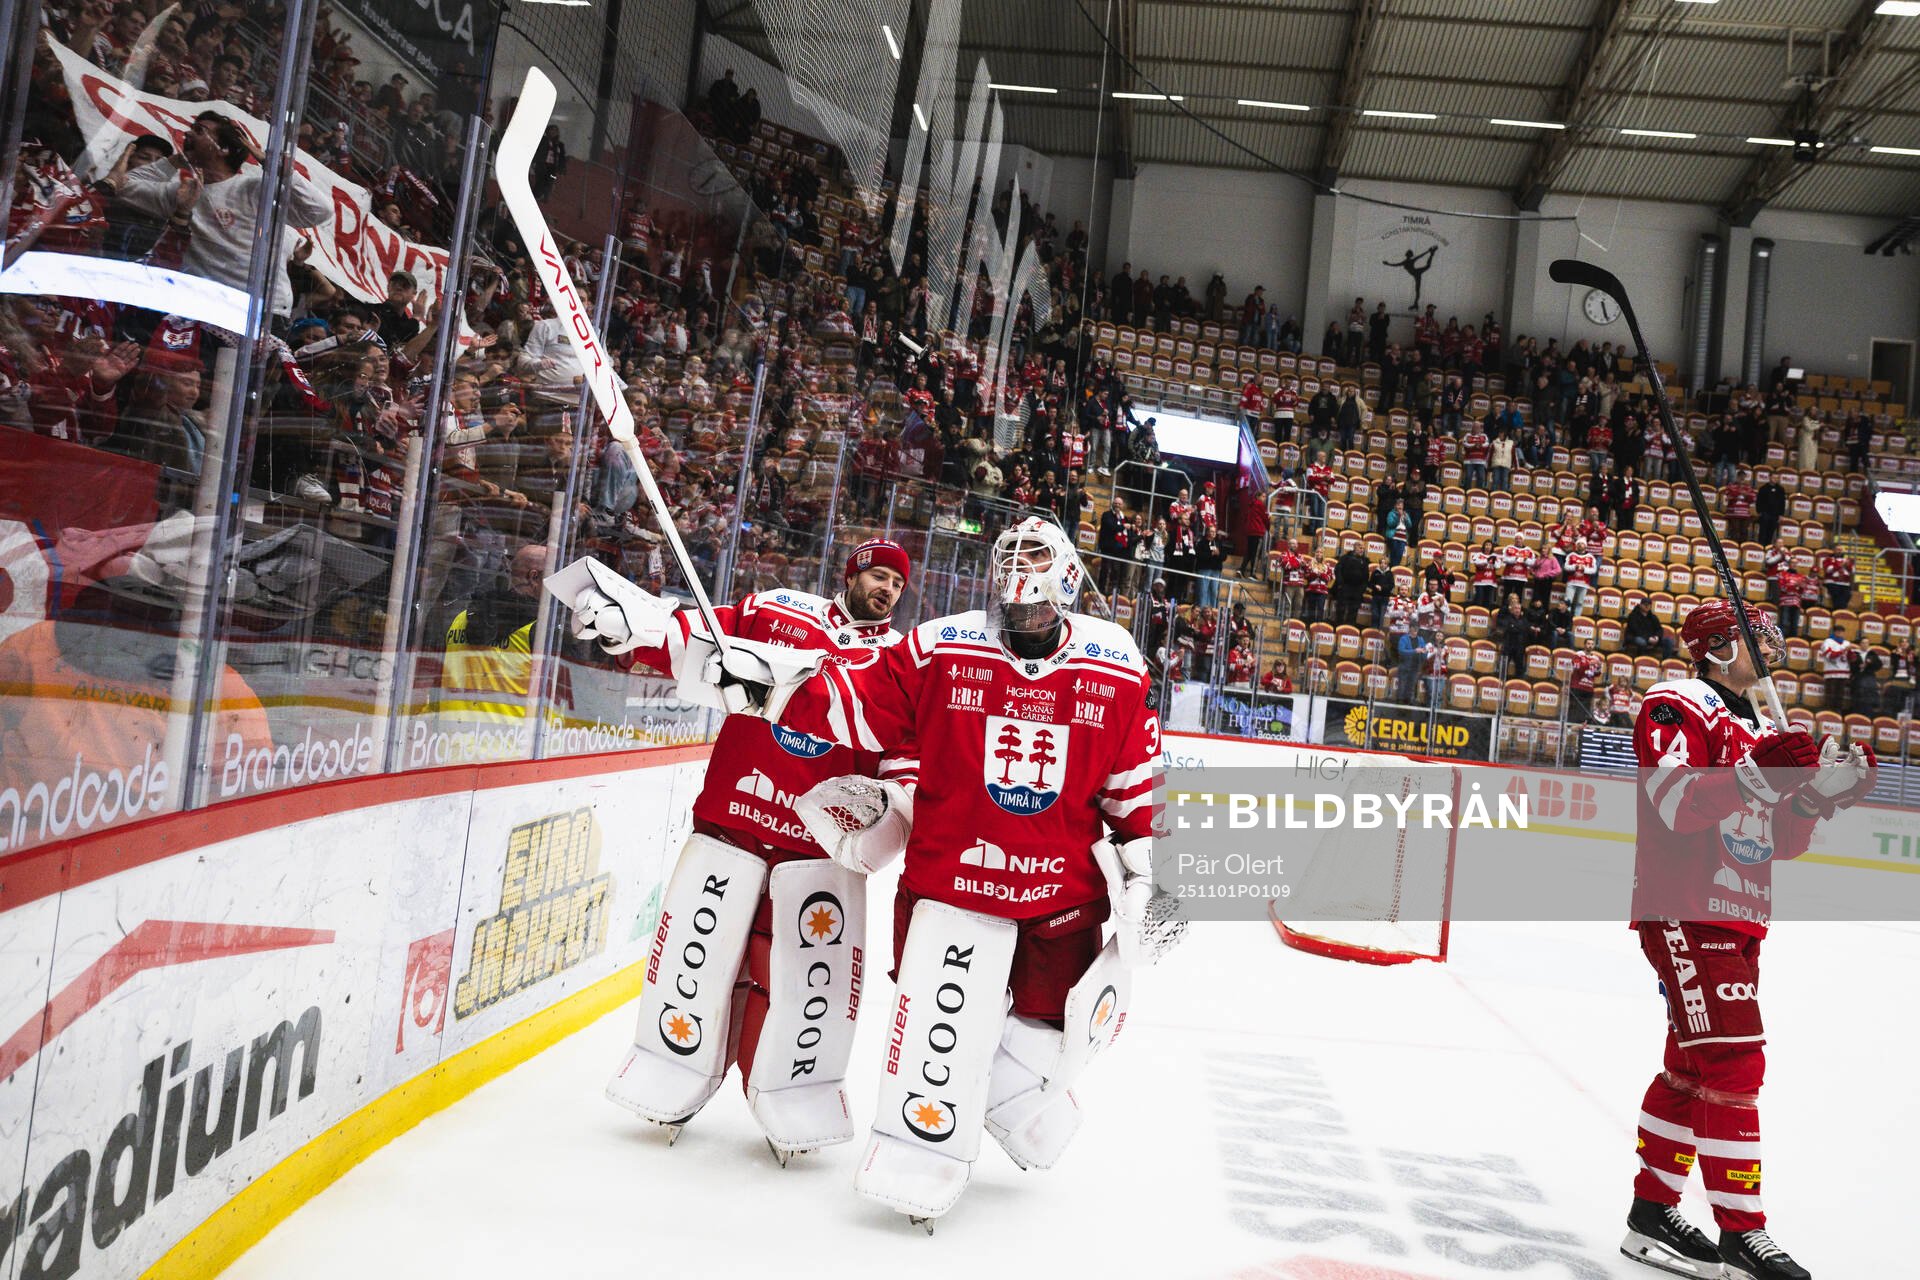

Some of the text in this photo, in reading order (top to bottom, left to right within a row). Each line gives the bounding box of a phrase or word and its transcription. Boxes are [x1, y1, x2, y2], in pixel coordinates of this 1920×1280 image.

[540, 231, 602, 384] VAPOR
[792, 600, 814, 612] SCA
[780, 622, 808, 640] LILIUM
[960, 630, 987, 641] SCA
[1104, 648, 1129, 663] SCA
[962, 666, 993, 682] LILIUM
[1006, 685, 1056, 701] HIGHCON
[1086, 681, 1116, 699] LILIUM
[1021, 711, 1053, 722] GÅRDEN
[1229, 714, 1272, 730] HUET
[779, 731, 818, 755] TIMRÅ IK
[1651, 729, 1690, 766] 14
[1176, 756, 1205, 771] SCA
[999, 791, 1042, 809] TIMRÅ IK
[1503, 776, 1598, 821] ABB
[1732, 841, 1755, 858] TIMRÅ
[501, 810, 591, 911] EURO
[1009, 855, 1065, 874] NHC
[954, 876, 1063, 902] BILBOLAGET
[1050, 910, 1081, 928] BAUER
[455, 877, 611, 1015] JACKPOT
[676, 874, 730, 1000] COOR
[1701, 942, 1736, 950] BAUER
[647, 911, 673, 985] BAUER
[846, 946, 863, 1021] BAUER
[790, 961, 831, 1081] COOR
[922, 944, 975, 1087] COOR
[887, 993, 911, 1076] BAUER
